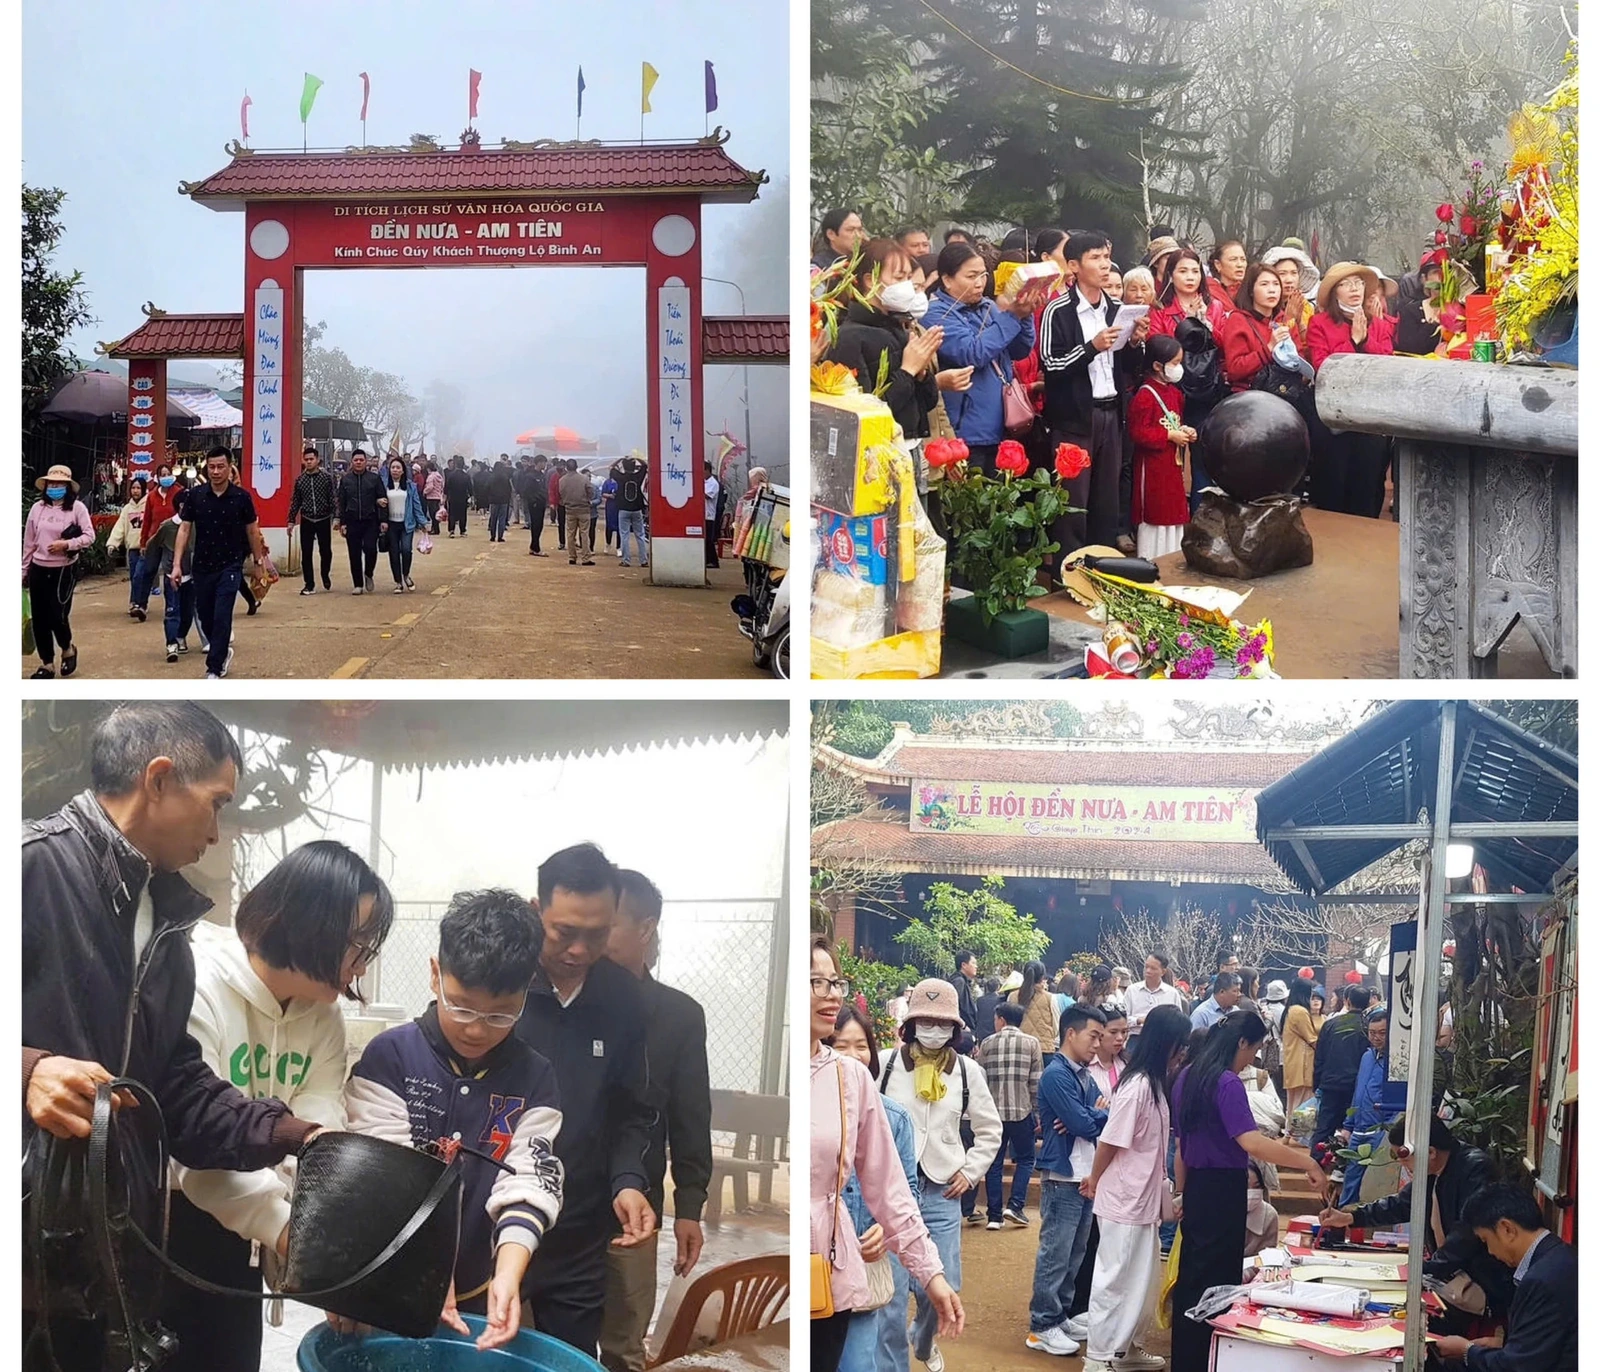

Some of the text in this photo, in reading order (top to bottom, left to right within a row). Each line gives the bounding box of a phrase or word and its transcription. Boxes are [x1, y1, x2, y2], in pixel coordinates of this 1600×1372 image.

[334, 200, 605, 217] DI TÍCH LỊCH SỬ VĂN HÓA QUỐC GIA
[370, 219, 410, 239] ĐỀN
[416, 222, 459, 239] NƯA
[476, 222, 510, 239] AM
[517, 218, 562, 238] TIÊN
[334, 246, 363, 257] Kính
[366, 246, 399, 257] Chúc
[432, 245, 474, 257] Khách
[476, 245, 526, 258] Thượng
[529, 244, 546, 258] Lộ
[548, 244, 578, 256] Bình
[582, 244, 602, 255] An
[670, 382, 680, 400] Đi
[668, 409, 683, 432] Tiếp
[262, 429, 273, 446] Xa
[670, 435, 682, 458] Tục
[259, 455, 274, 472] Đến
[956, 785, 982, 815] LỄ
[987, 790, 1026, 821] HỘI
[1030, 788, 1075, 819] ĐỀN
[1081, 797, 1128, 820] NƯA
[1142, 800, 1177, 821] AM
[1182, 795, 1236, 822] TIÊN
[478, 1093, 526, 1143] K
[489, 1131, 514, 1161] 7
